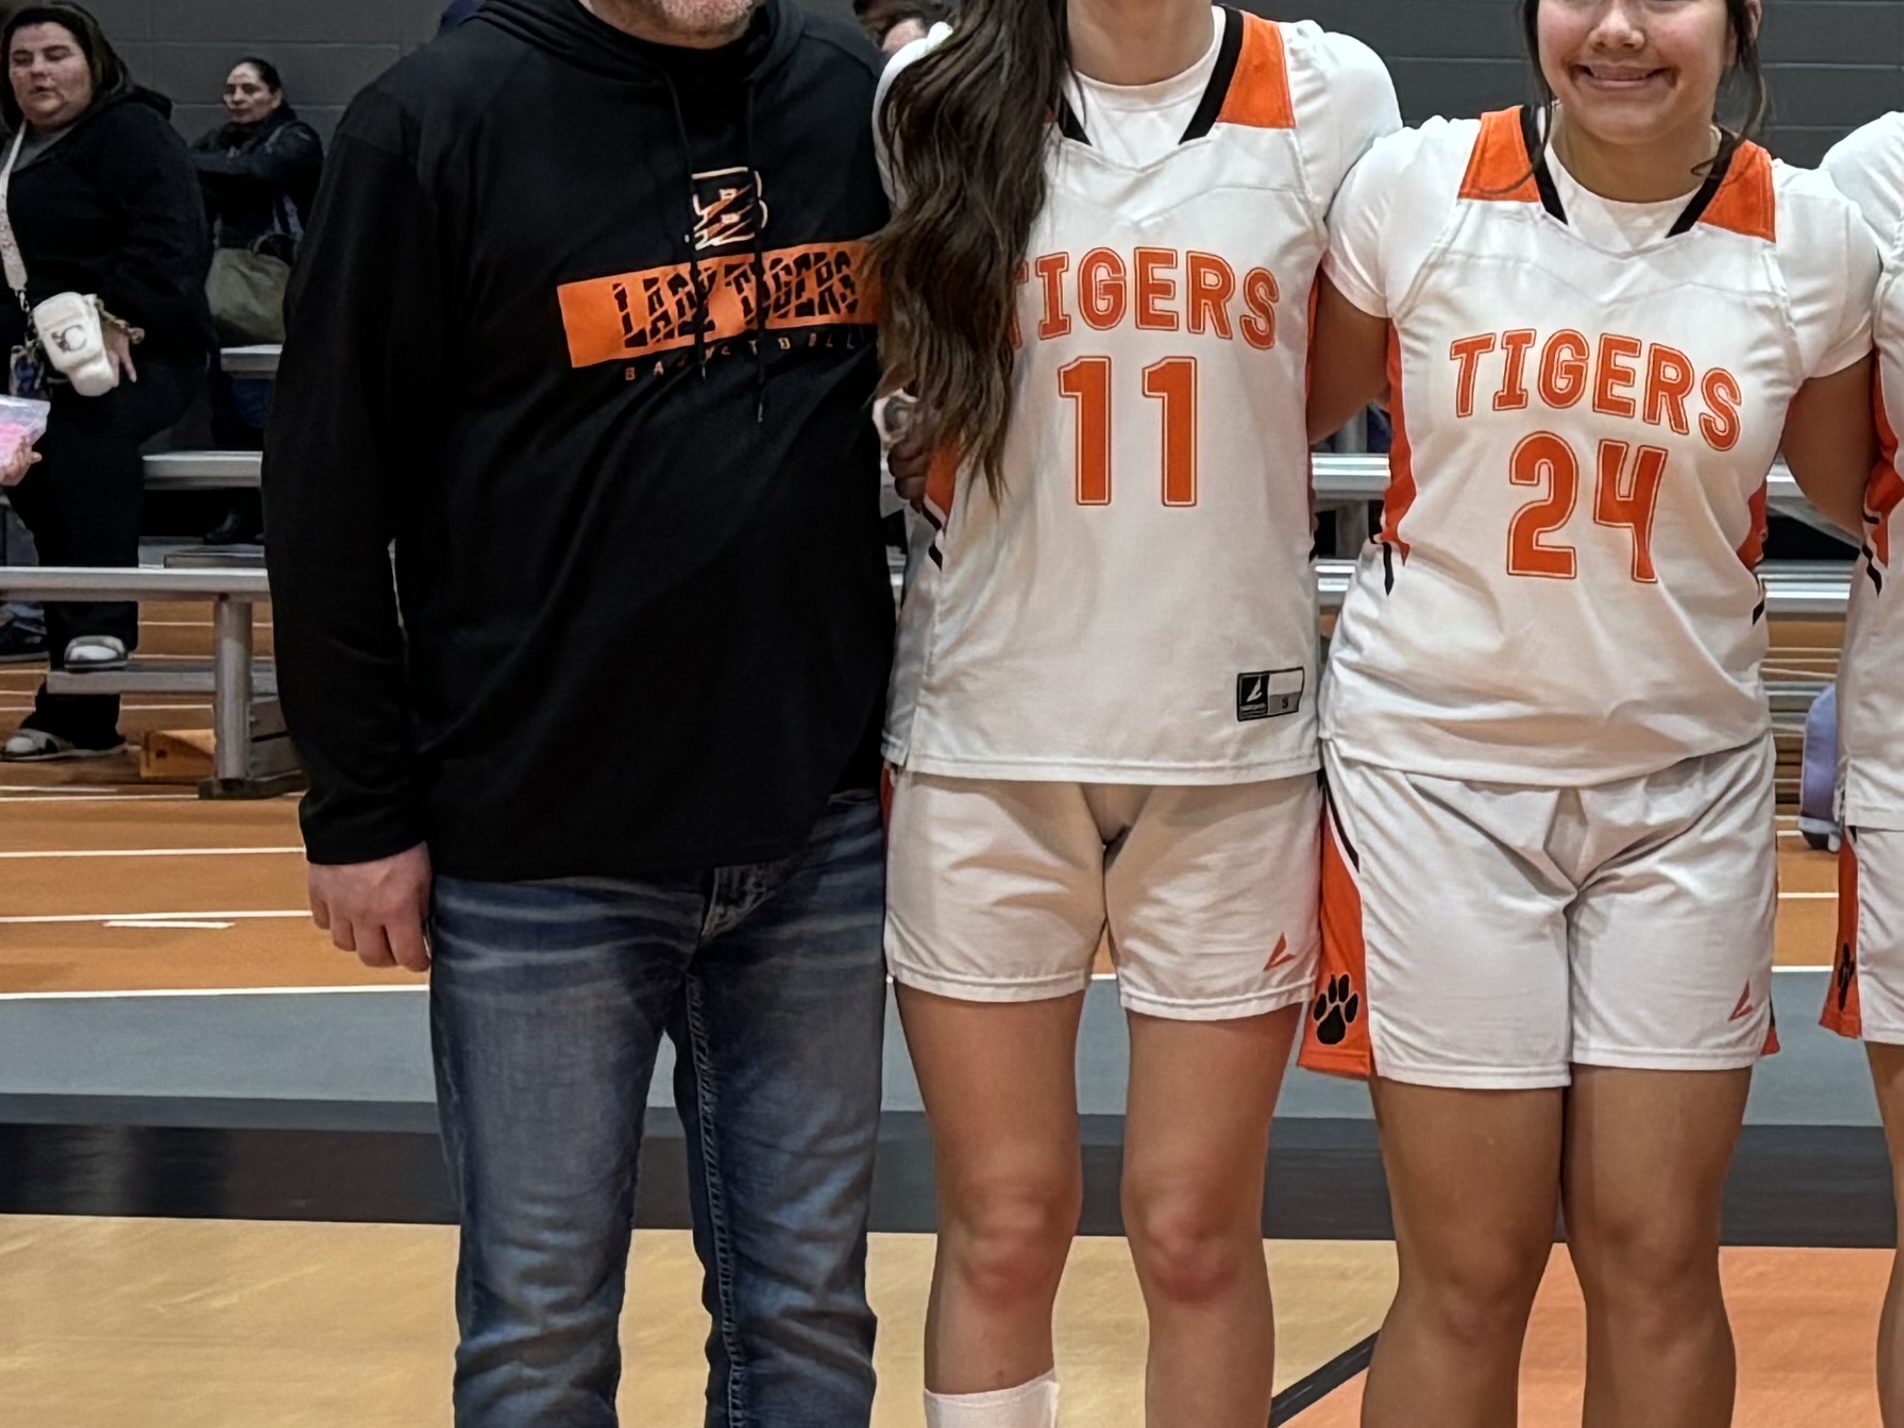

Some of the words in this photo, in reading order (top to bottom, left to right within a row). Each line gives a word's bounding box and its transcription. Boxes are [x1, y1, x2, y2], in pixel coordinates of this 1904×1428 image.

[1057, 355, 1197, 506] 11
[1450, 329, 1742, 452] TIGERS
[1507, 430, 1668, 583] 24
